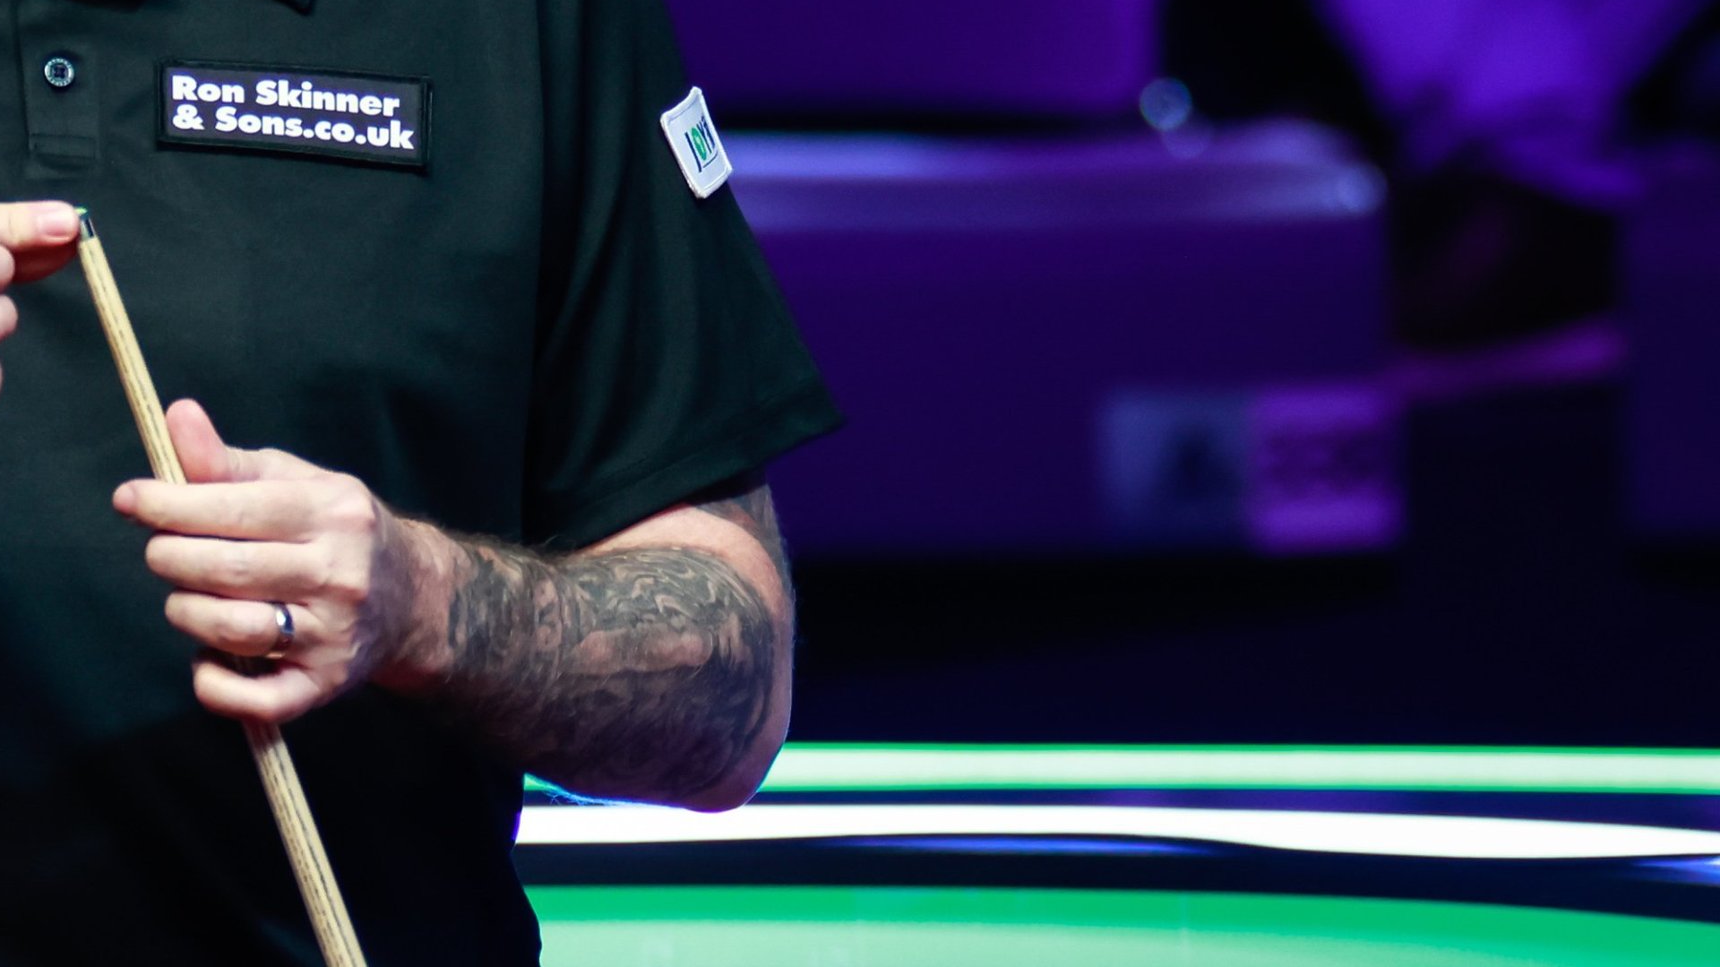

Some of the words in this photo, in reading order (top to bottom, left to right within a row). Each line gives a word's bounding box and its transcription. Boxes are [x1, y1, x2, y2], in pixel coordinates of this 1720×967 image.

[172, 75, 245, 103] Ron
[255, 79, 400, 117] Skinner
[172, 104, 205, 130] &
[215, 105, 415, 149] Sons.co.uk
